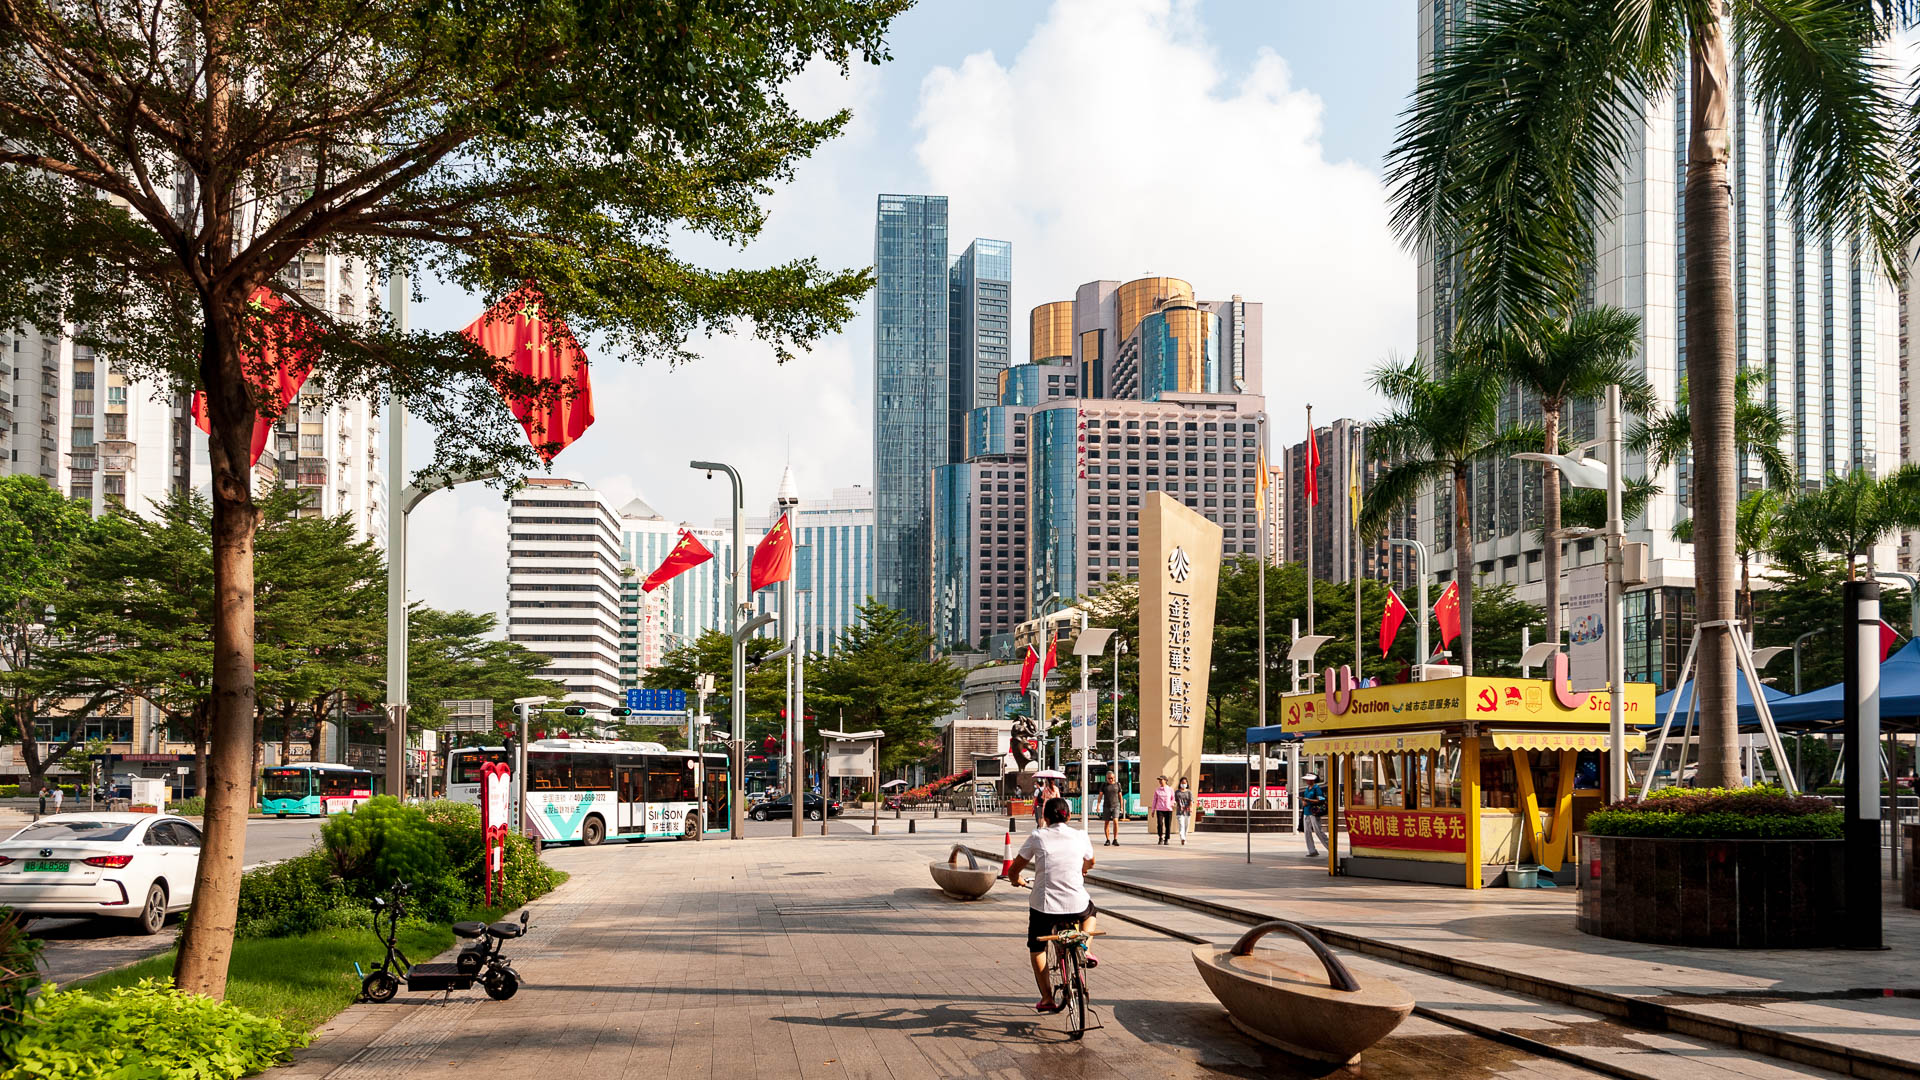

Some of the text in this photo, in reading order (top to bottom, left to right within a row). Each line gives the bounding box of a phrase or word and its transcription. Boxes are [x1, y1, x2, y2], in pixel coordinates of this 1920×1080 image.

[1168, 596, 1182, 724] 金光華廣場
[1352, 699, 1389, 714] Station
[1405, 697, 1460, 712] 城市志愿服务站
[1589, 695, 1638, 711] Staon
[648, 808, 683, 821] SIMSON
[1347, 814, 1465, 839] 文明创建 志愿争先
